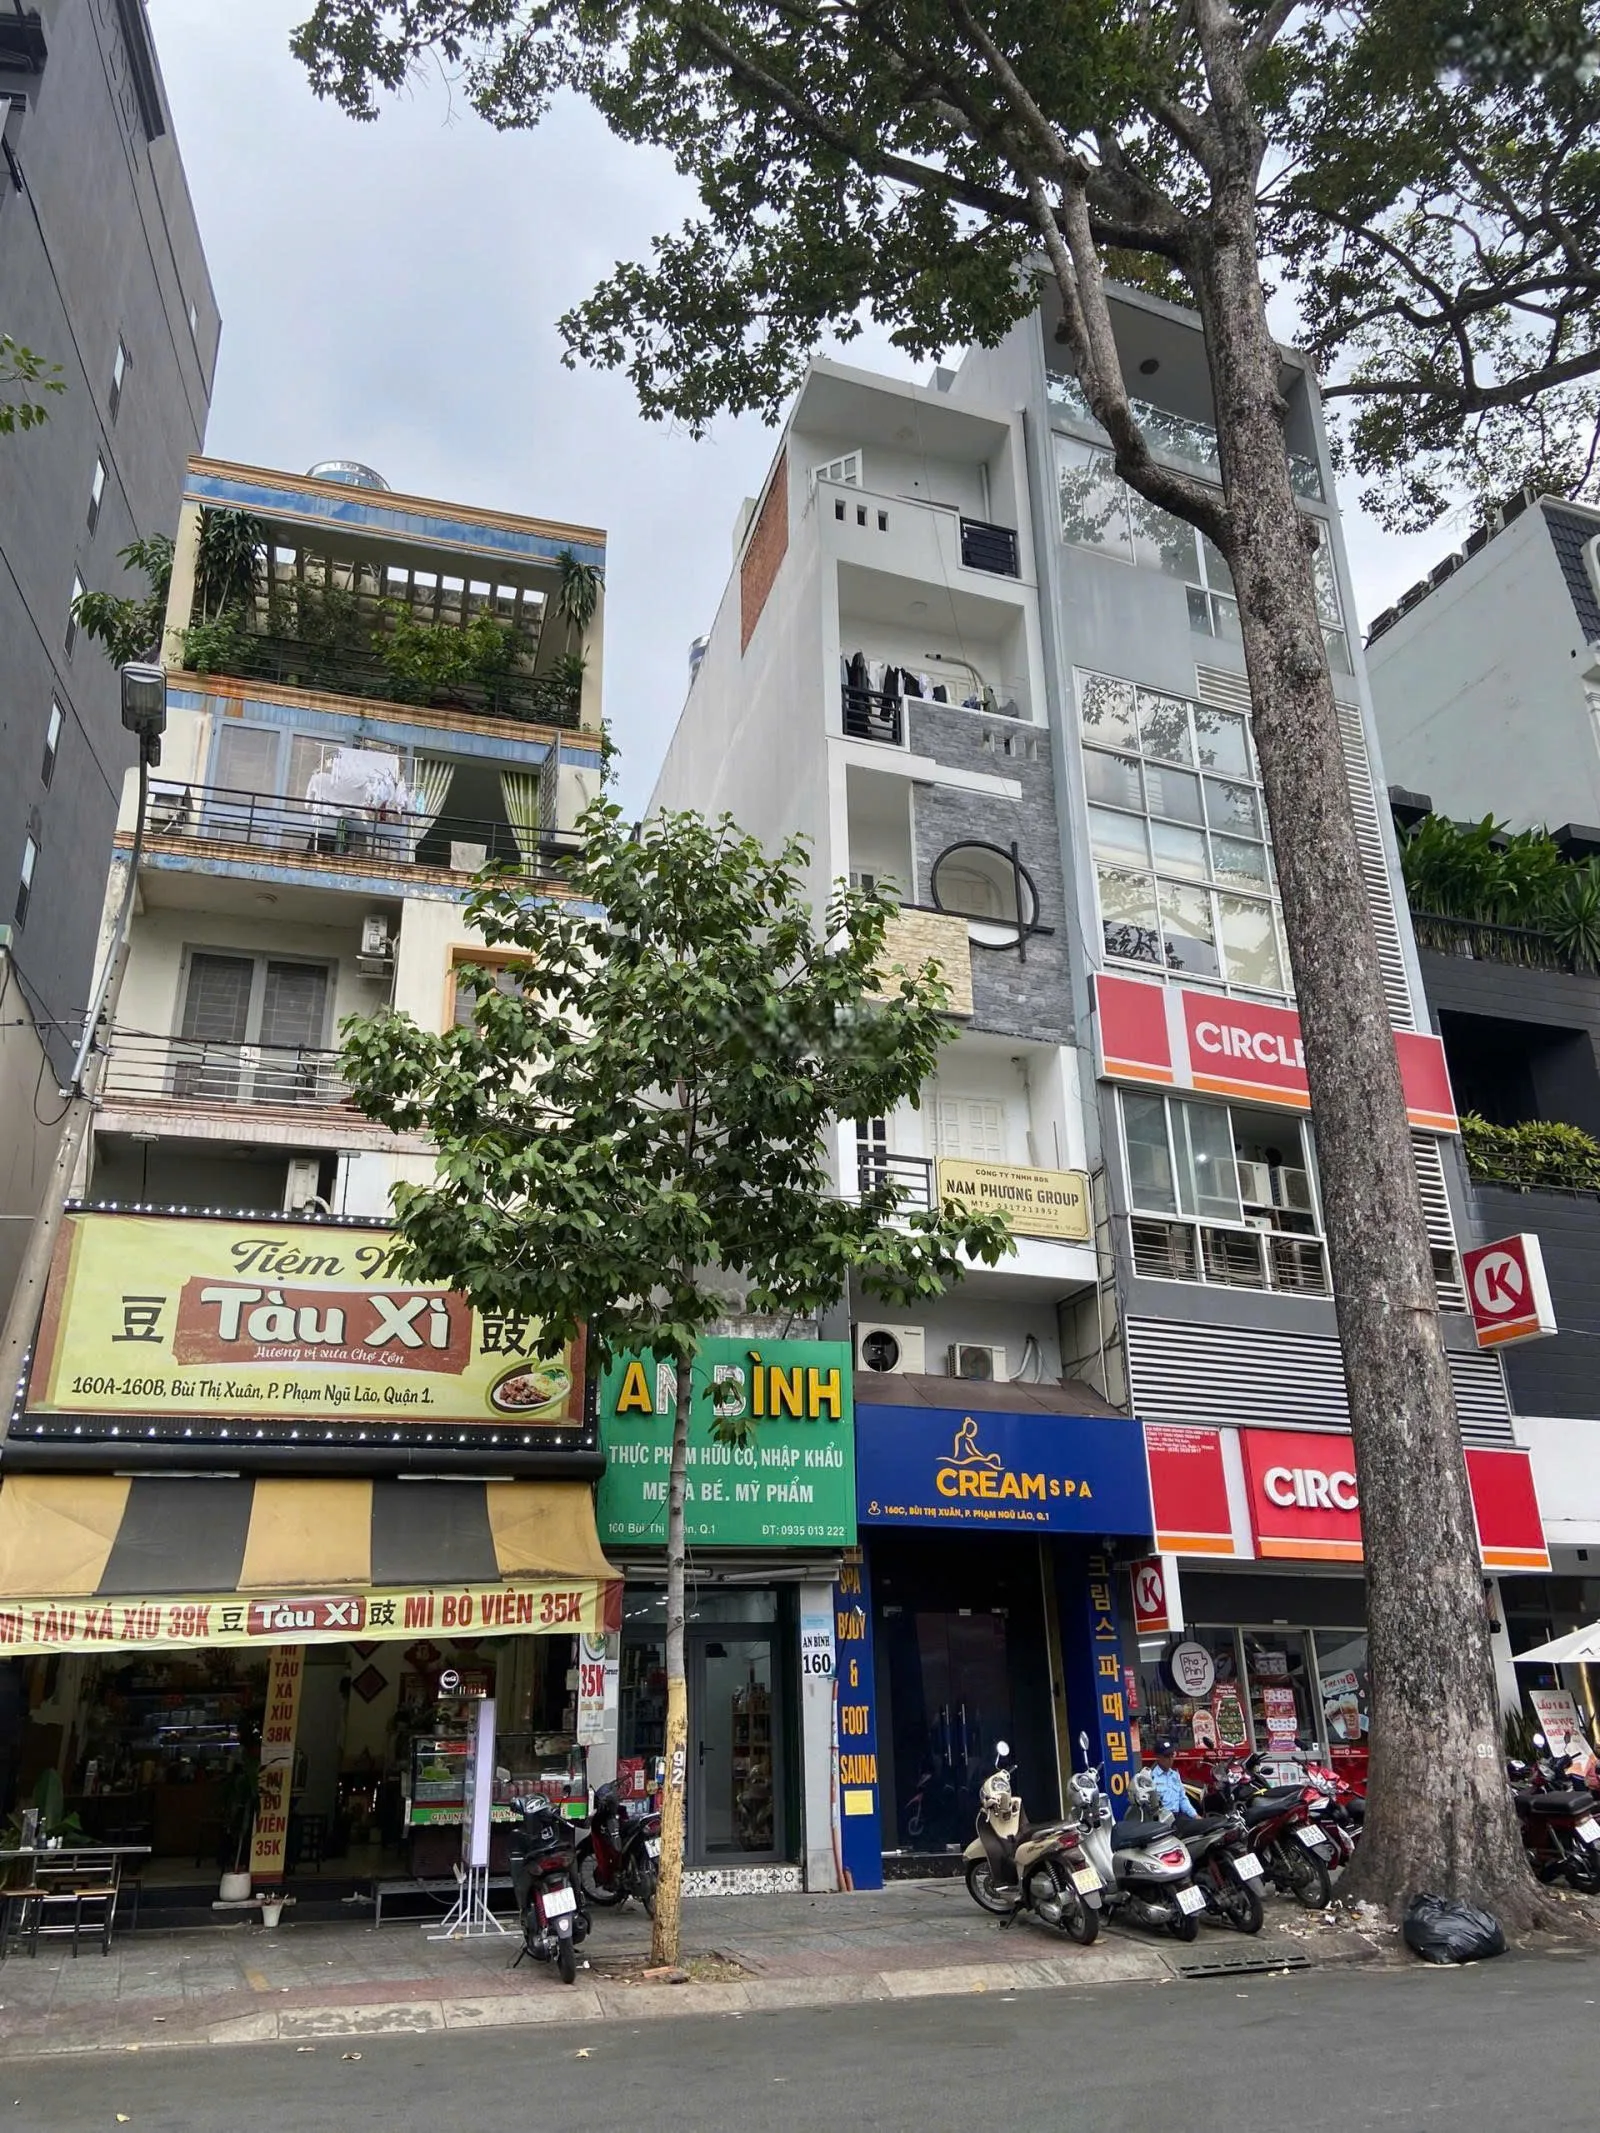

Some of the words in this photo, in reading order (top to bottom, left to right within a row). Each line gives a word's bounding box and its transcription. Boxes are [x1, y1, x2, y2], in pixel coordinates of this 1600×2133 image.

[946, 1179, 975, 1195] NAM
[980, 1184, 1033, 1202] PHƯƠNG
[1037, 1190, 1079, 1207] GROUP
[231, 1239, 344, 1281] Tiệm
[112, 1296, 167, 1344] 豆
[200, 1286, 346, 1345] Tàu
[363, 1294, 450, 1350] Xì
[253, 1346, 301, 1361] Hương
[304, 1347, 318, 1361] vị
[351, 1348, 376, 1363] Chợ
[378, 1350, 405, 1365] Lớn
[71, 1376, 167, 1397] 160A-160B,
[171, 1380, 197, 1397] Bùi
[199, 1380, 222, 1401] Thị
[223, 1381, 263, 1400] Xuân,
[267, 1382, 279, 1400] P.
[282, 1382, 321, 1404] Phạm
[324, 1384, 351, 1406] Ngũ
[354, 1385, 381, 1404] Lão,
[383, 1386, 418, 1407] Quận
[421, 1387, 434, 1404] 1.
[713, 1351, 842, 1419] BÌNH
[609, 1442, 650, 1468] THỰC
[654, 1446, 697, 1465] PHM
[701, 1441, 731, 1466] HỮU
[734, 1445, 758, 1470] CƠ,
[761, 1445, 800, 1471] NHẬP
[804, 1441, 843, 1469] KHẨU
[643, 1482, 669, 1505] MẸ
[735, 1480, 761, 1503] MỸ
[766, 1475, 814, 1504] PHẨM
[936, 1468, 1047, 1501] CREAM
[1050, 1479, 1092, 1498] SPA
[909, 1505, 923, 1516] BÙI
[924, 1507, 937, 1518] THỊ
[965, 1509, 972, 1517] P.
[973, 1510, 997, 1521] PHẠM
[781, 1525, 805, 1536] 0935
[807, 1526, 824, 1536] 013
[827, 1526, 845, 1537] 222
[840, 1567, 861, 1594] SPA
[0, 1605, 24, 1643] MÌ
[31, 1603, 76, 1642] TÀU
[81, 1602, 113, 1641] XÁ
[120, 1601, 162, 1640] XÍU
[167, 1605, 212, 1638] 38K
[218, 1607, 244, 1633] 豆
[255, 1604, 316, 1630] Tàu
[323, 1600, 360, 1627] Xì
[369, 1600, 396, 1626] 豉
[404, 1590, 434, 1628] MÌ
[441, 1588, 473, 1627] BÒ
[481, 1588, 533, 1626] VIÊN
[540, 1592, 583, 1623] 35K
[802, 1636, 814, 1648] AN
[816, 1632, 830, 1648] BÌNH
[837, 1612, 866, 1640] BODY
[275, 1659, 299, 1678] TÀU
[803, 1653, 831, 1674] 160
[849, 1659, 858, 1687] &
[275, 1681, 293, 1698] XÁ
[581, 1664, 605, 1697] 35K
[271, 1703, 293, 1721] XÍU
[842, 1706, 868, 1735] FOOT
[267, 1728, 291, 1742] 38K
[840, 1754, 877, 1784] SAUNA
[256, 1813, 285, 1833] VIÊN
[256, 1840, 280, 1857] 35K
